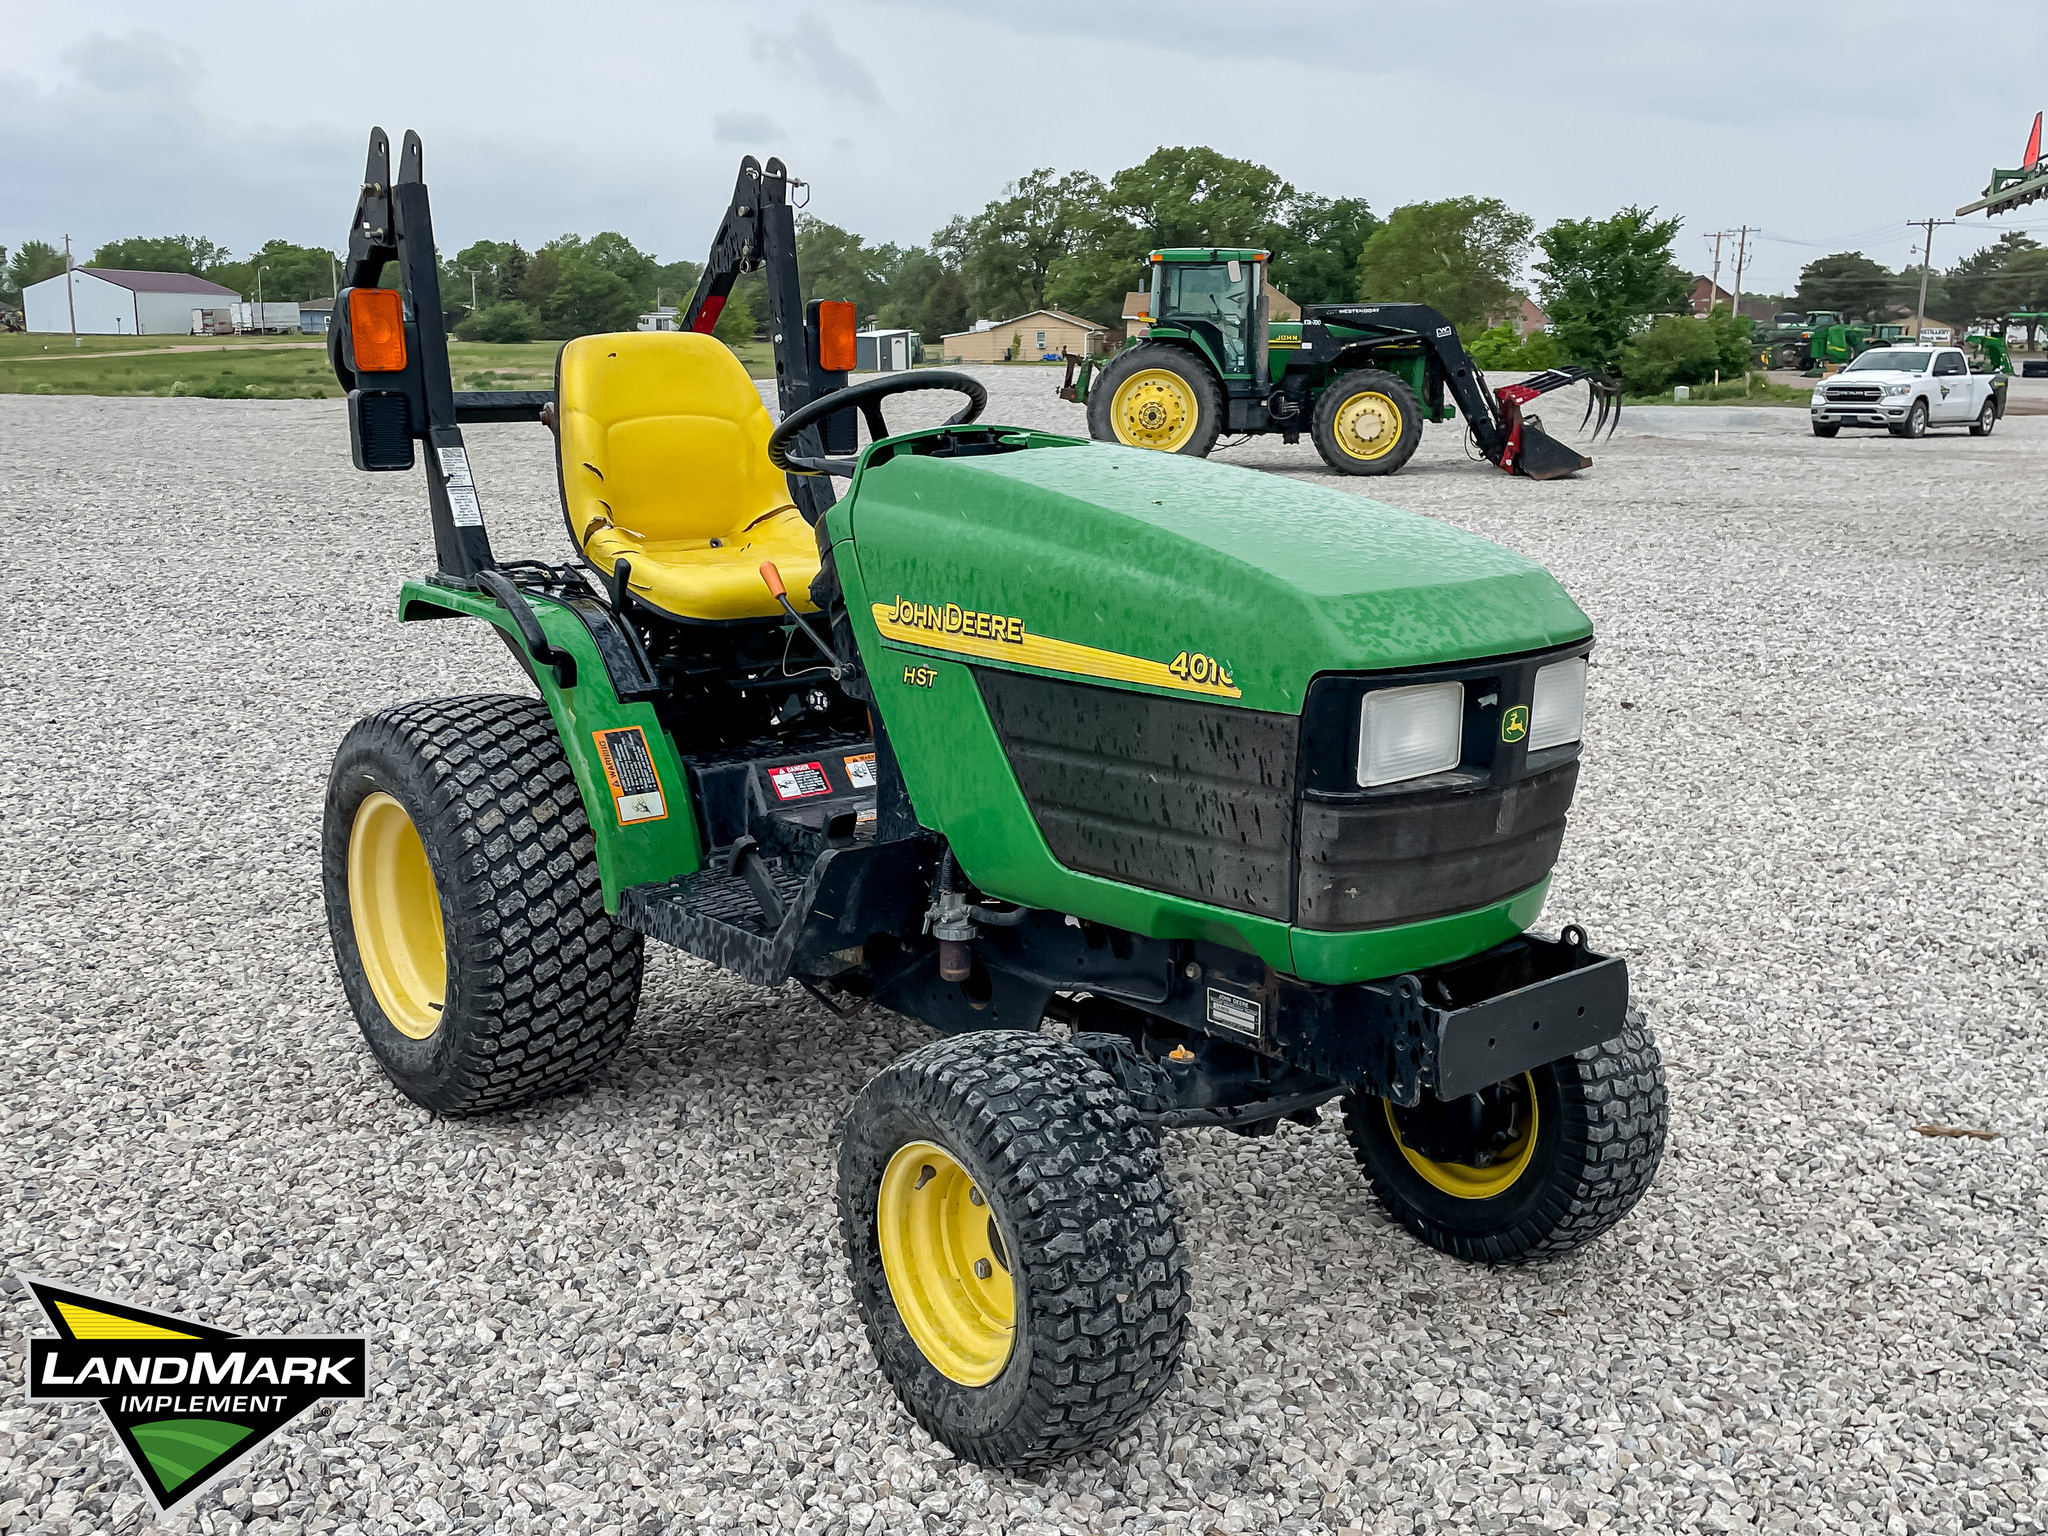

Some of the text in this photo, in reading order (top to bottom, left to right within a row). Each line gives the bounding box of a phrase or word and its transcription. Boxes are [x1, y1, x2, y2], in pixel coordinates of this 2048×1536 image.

[888, 594, 1024, 645] JOHN DEERE
[903, 666, 938, 688] HST
[599, 740, 617, 779] WARNING
[786, 763, 811, 773] DANGER
